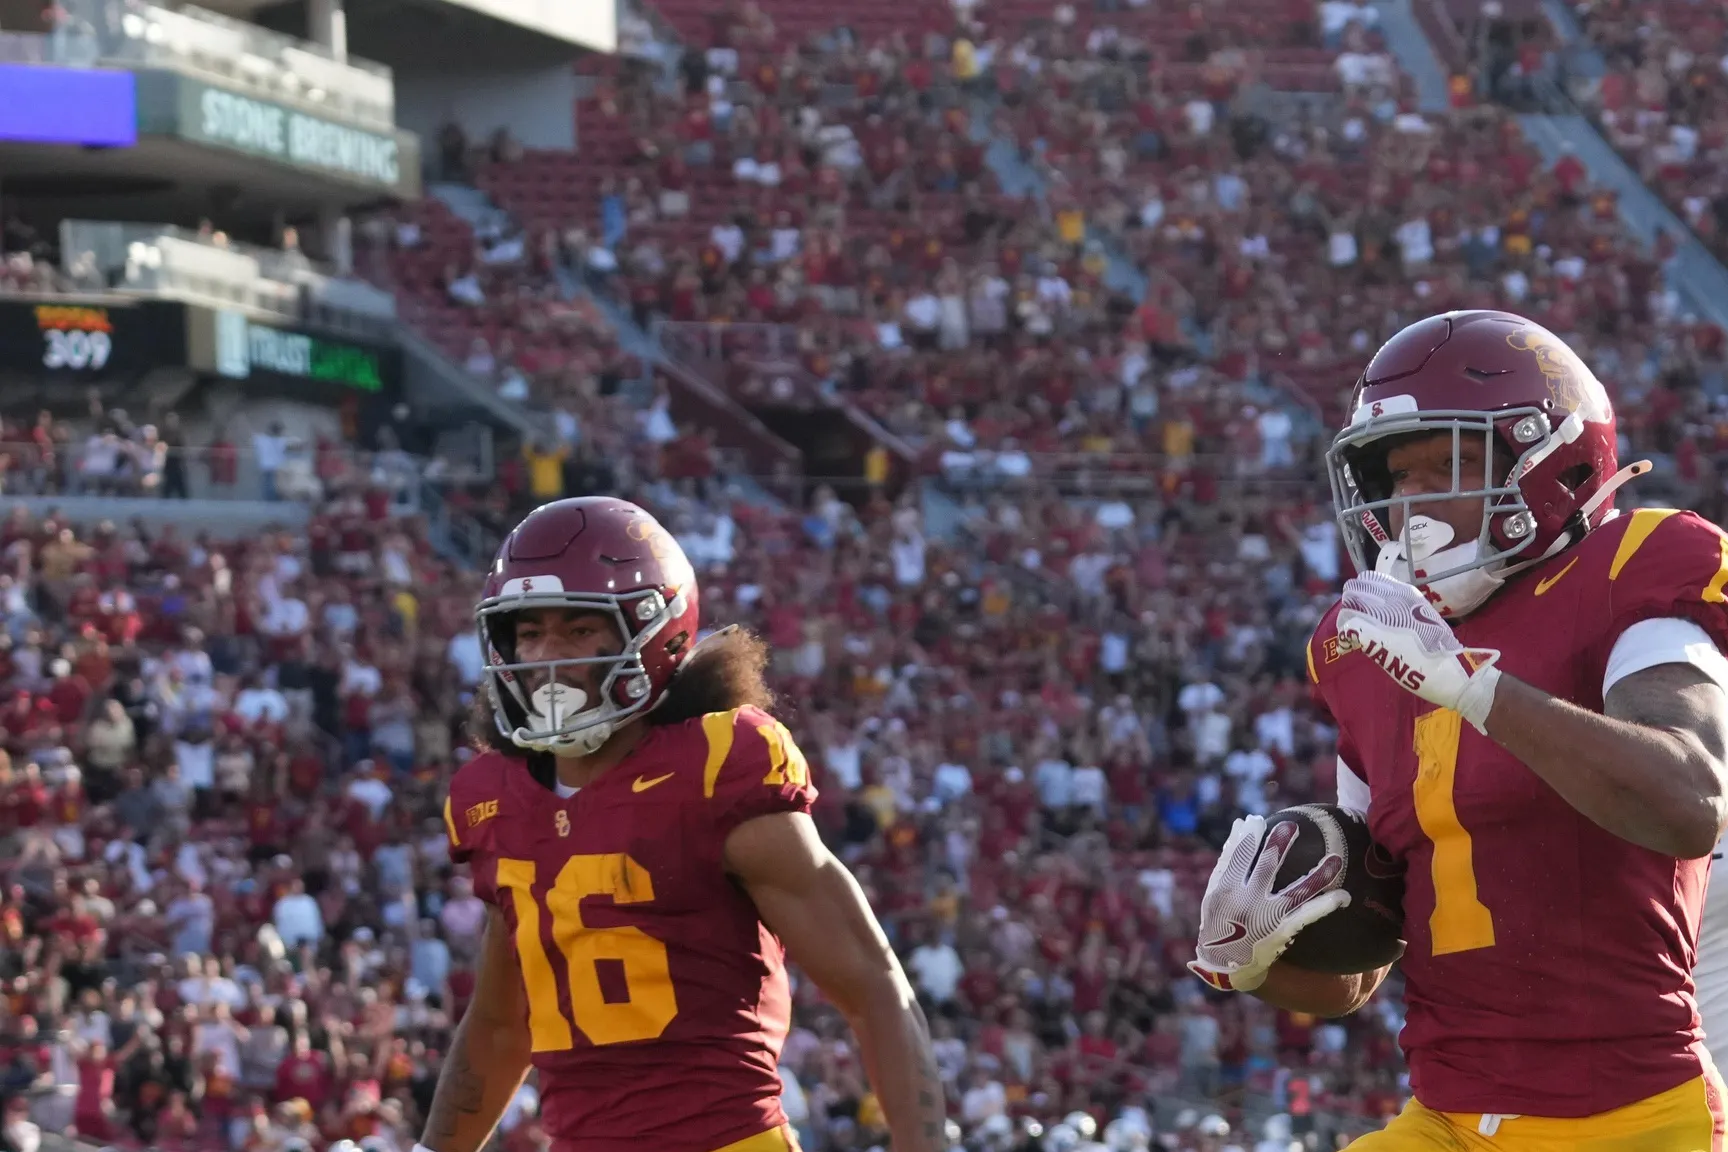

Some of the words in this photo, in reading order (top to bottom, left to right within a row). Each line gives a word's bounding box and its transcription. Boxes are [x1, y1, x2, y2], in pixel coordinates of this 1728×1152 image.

[43, 329, 111, 369] 309
[1412, 707, 1496, 957] 1
[496, 852, 679, 1053] 16
